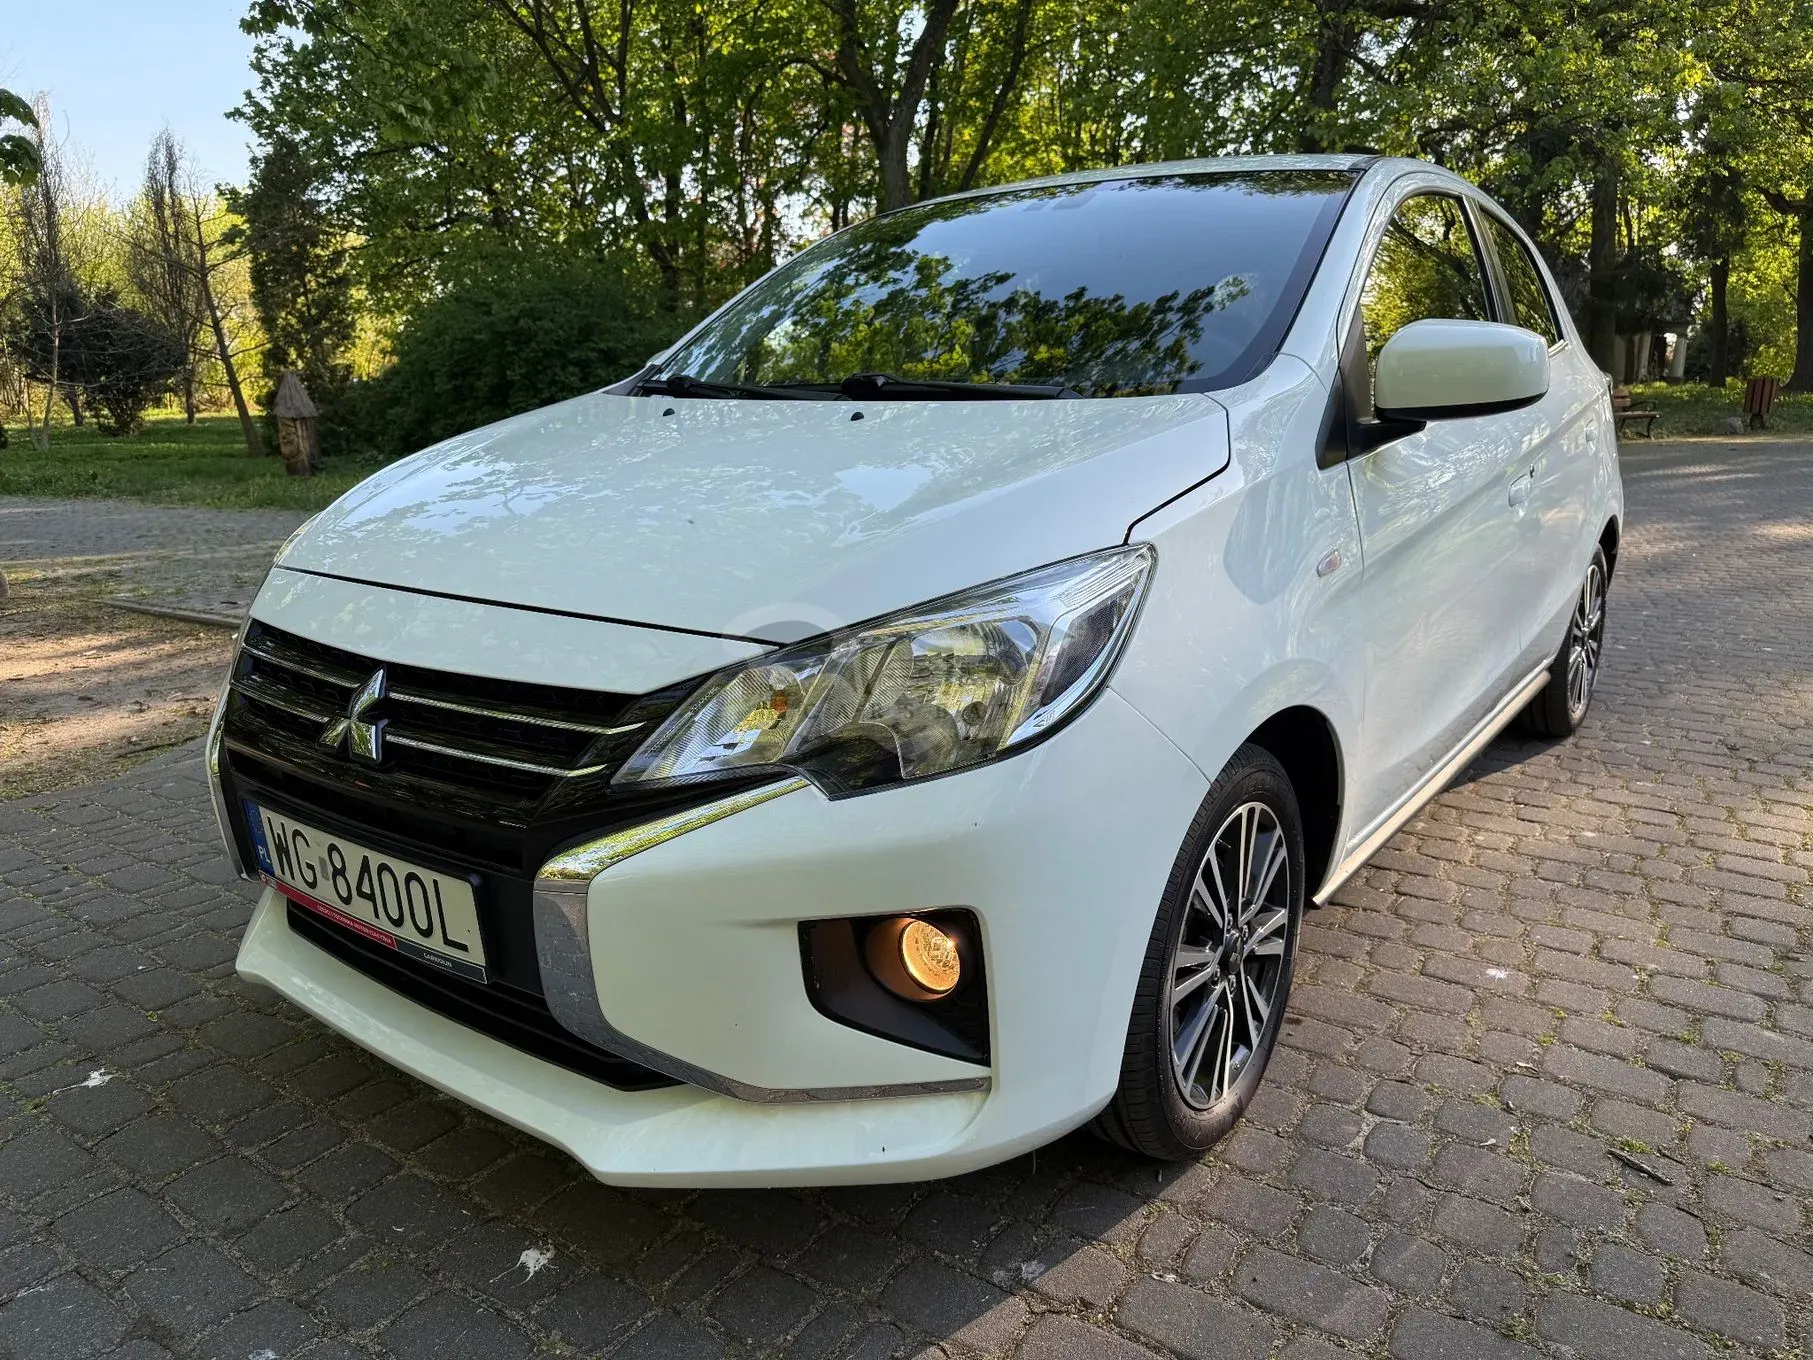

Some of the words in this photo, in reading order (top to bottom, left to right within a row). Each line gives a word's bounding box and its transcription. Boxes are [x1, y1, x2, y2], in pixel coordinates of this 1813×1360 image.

[257, 844, 271, 863] PL
[267, 815, 318, 890] WG
[327, 842, 470, 953] 8400L
